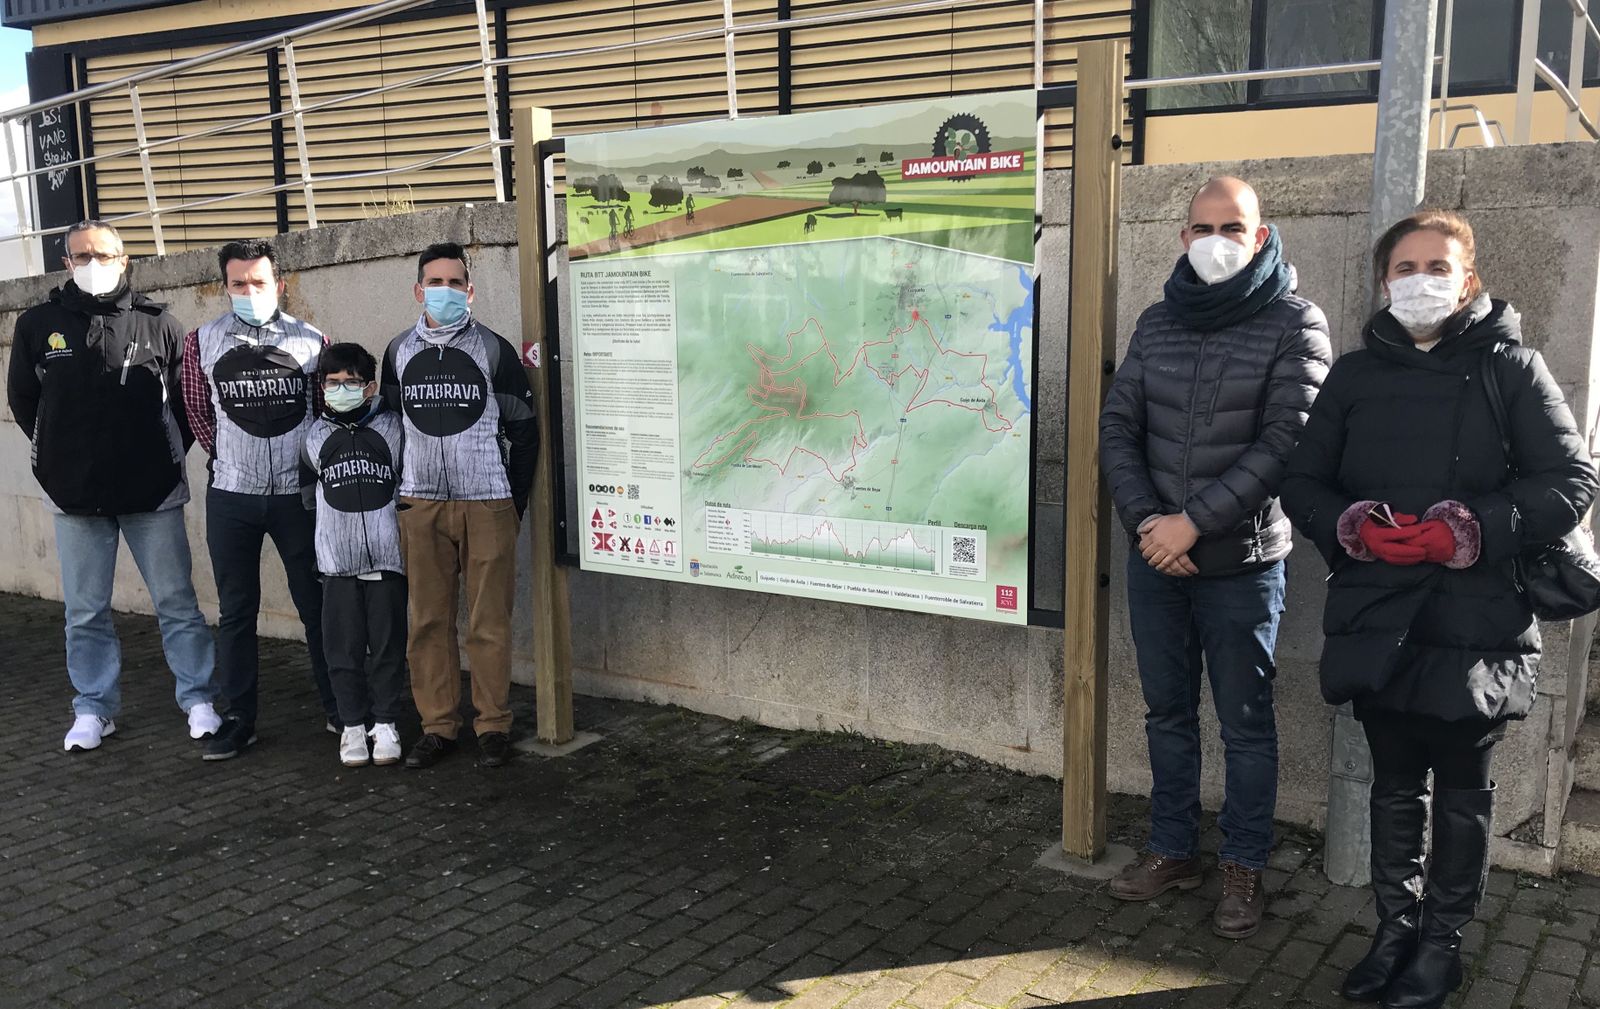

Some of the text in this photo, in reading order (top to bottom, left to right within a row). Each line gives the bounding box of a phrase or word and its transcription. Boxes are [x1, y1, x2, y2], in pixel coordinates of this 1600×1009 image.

[904, 155, 1021, 176] JAMOUNTAIN BIKE
[532, 350, 538, 360] S
[219, 377, 304, 399] PATABRAVA
[404, 383, 481, 401] PATABRAVA
[322, 459, 392, 483] PATABRAVA
[927, 519, 942, 527] Perfil
[953, 521, 977, 530] Descarga
[1000, 588, 1014, 597] 112
